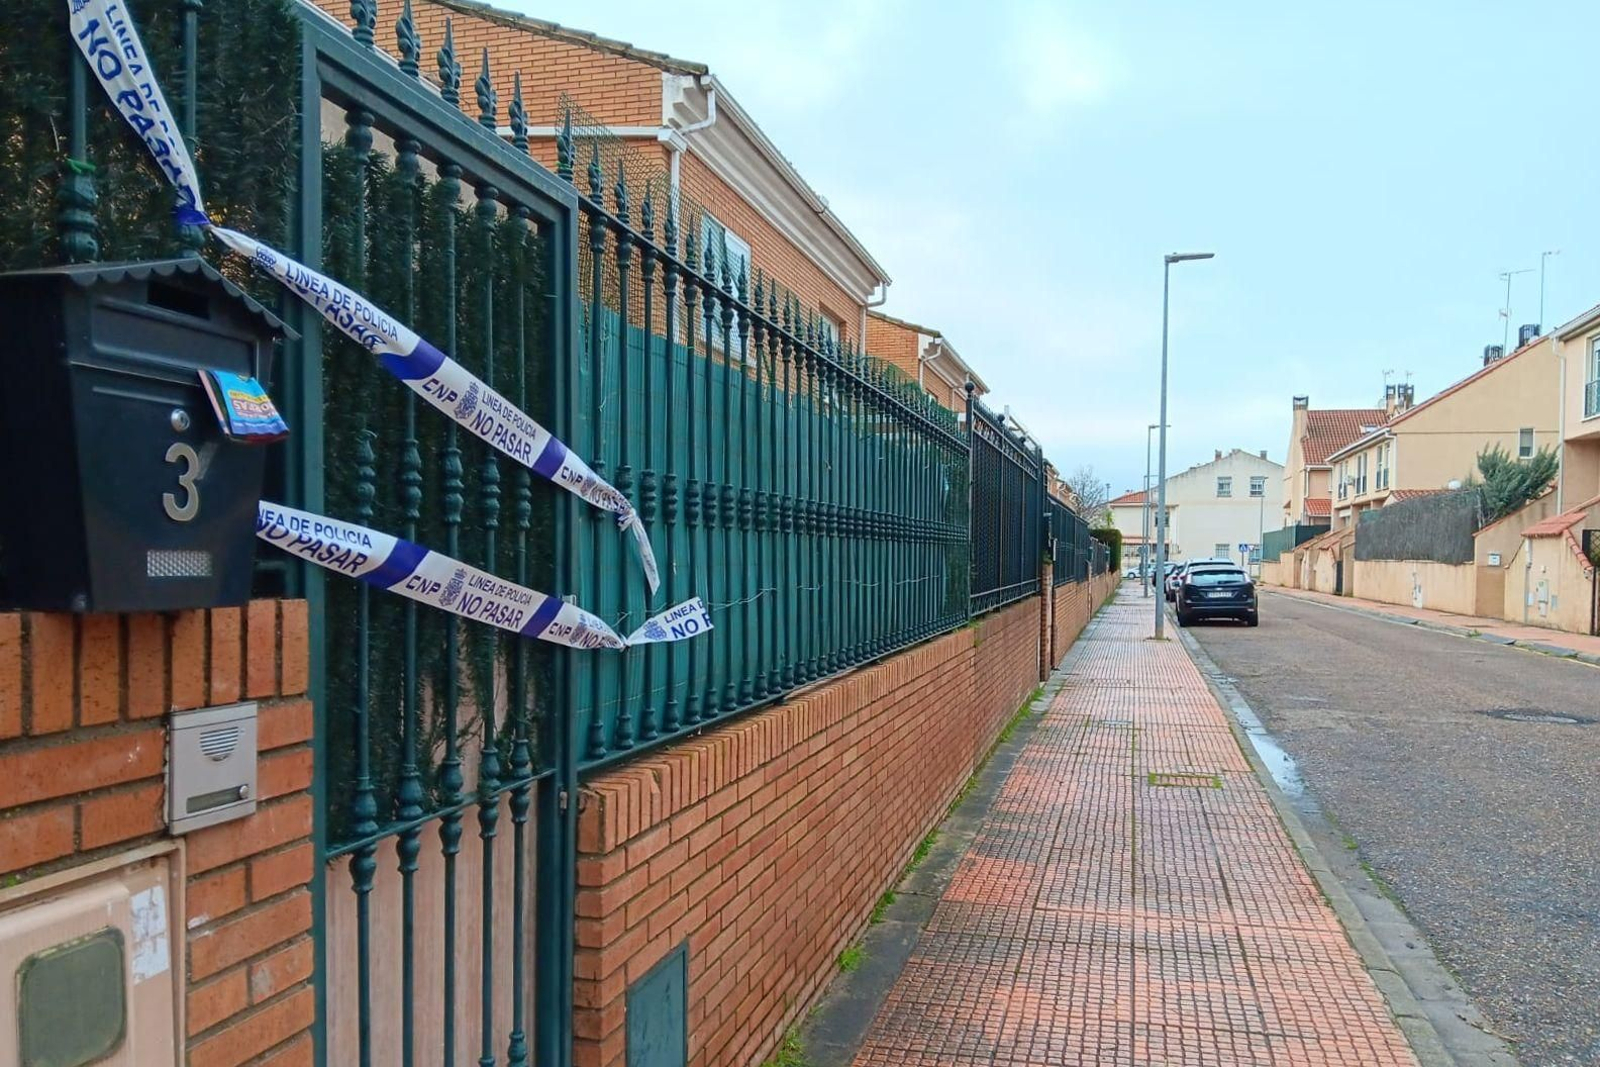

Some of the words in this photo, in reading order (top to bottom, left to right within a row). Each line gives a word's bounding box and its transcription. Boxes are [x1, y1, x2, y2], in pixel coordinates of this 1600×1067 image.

[78, 18, 122, 81] NO
[286, 263, 329, 299] LINEA
[333, 288, 352, 311] DE
[354, 302, 399, 341] POLICIA
[422, 378, 458, 405] CNP
[481, 391, 502, 413] LINEA
[502, 406, 513, 421] DE
[512, 413, 537, 440] POLICIA
[469, 410, 494, 436] NO
[491, 423, 532, 463] PASAR
[163, 442, 199, 522] 3
[561, 466, 583, 486] CNP
[290, 516, 310, 535] DE
[314, 522, 373, 549] POLICIA
[287, 533, 368, 574] PASAR
[405, 575, 441, 595] CNP
[468, 574, 495, 596] LINEA
[494, 585, 507, 597] DE
[506, 588, 533, 607] POLICIA
[456, 592, 482, 615] NO
[480, 600, 524, 629] PASAR
[664, 604, 697, 624] LINEA
[549, 622, 572, 637] CNP
[579, 631, 599, 648] NO
[671, 618, 700, 639] NO
